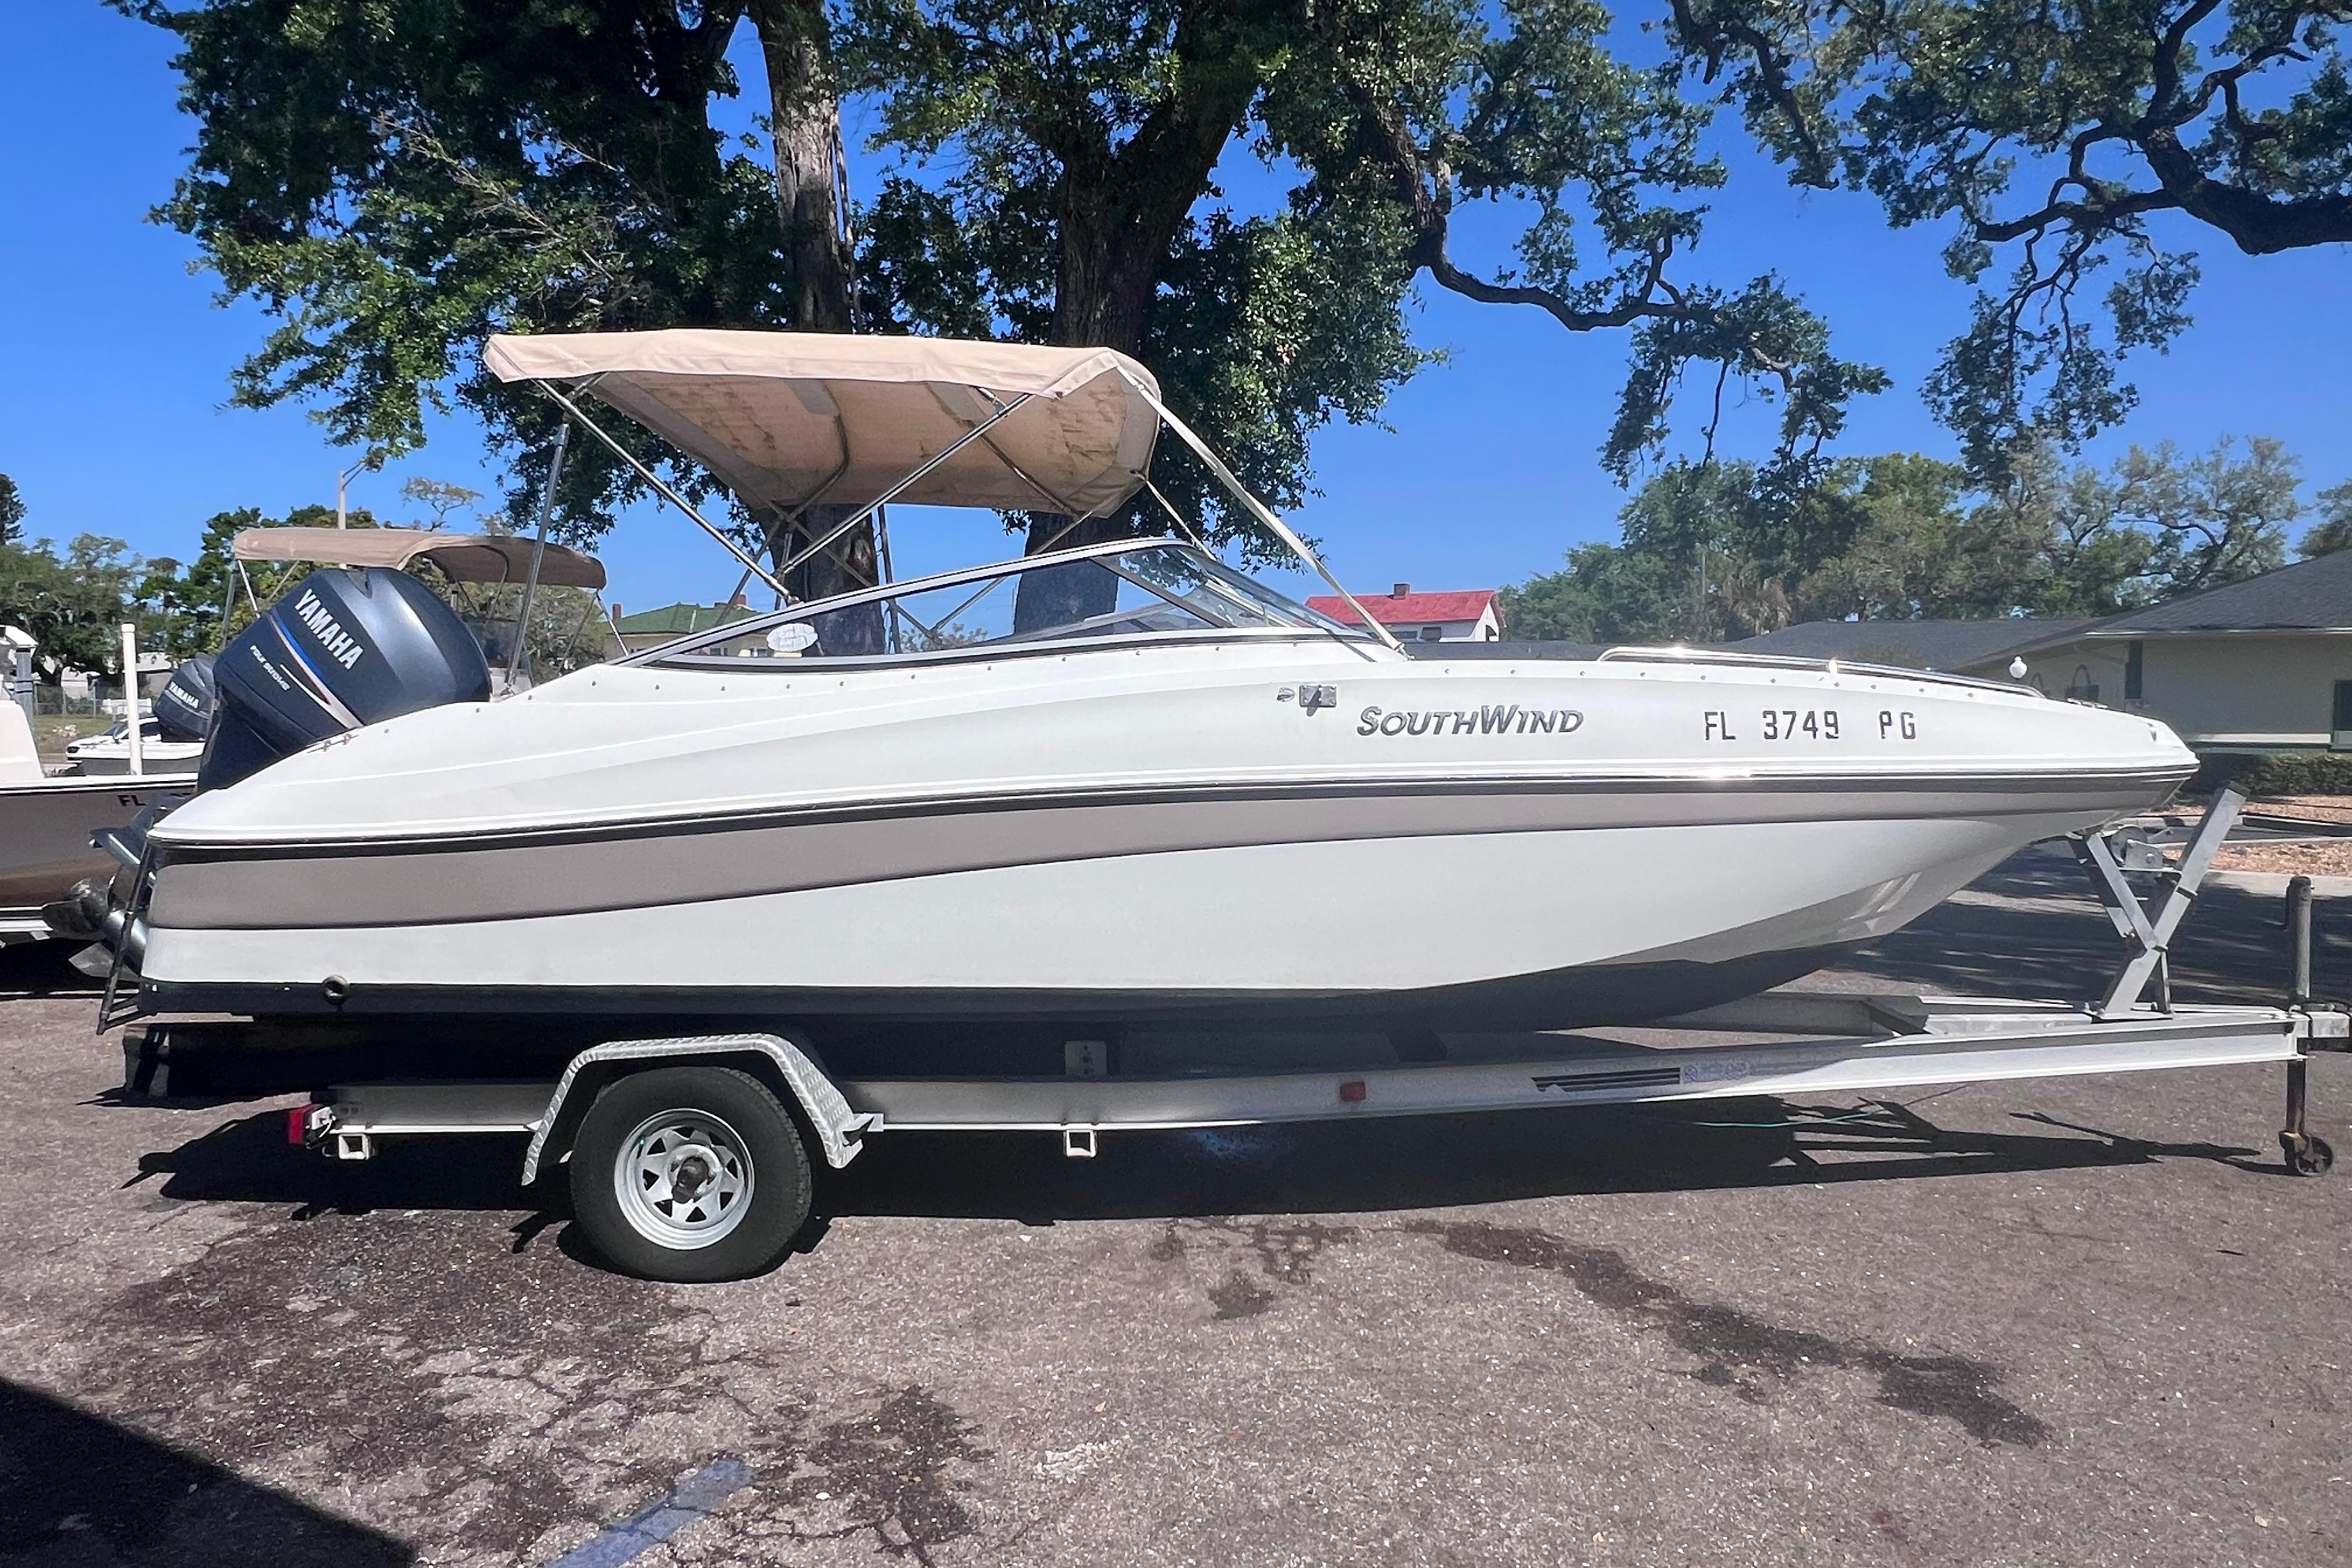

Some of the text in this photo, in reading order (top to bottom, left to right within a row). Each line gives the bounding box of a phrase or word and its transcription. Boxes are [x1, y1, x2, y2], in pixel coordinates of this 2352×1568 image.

[294, 588, 364, 670] YAMAHA
[169, 681, 200, 709] YAMAHA
[1704, 710, 1916, 741] FL 3749 PG
[117, 794, 147, 807] FL
